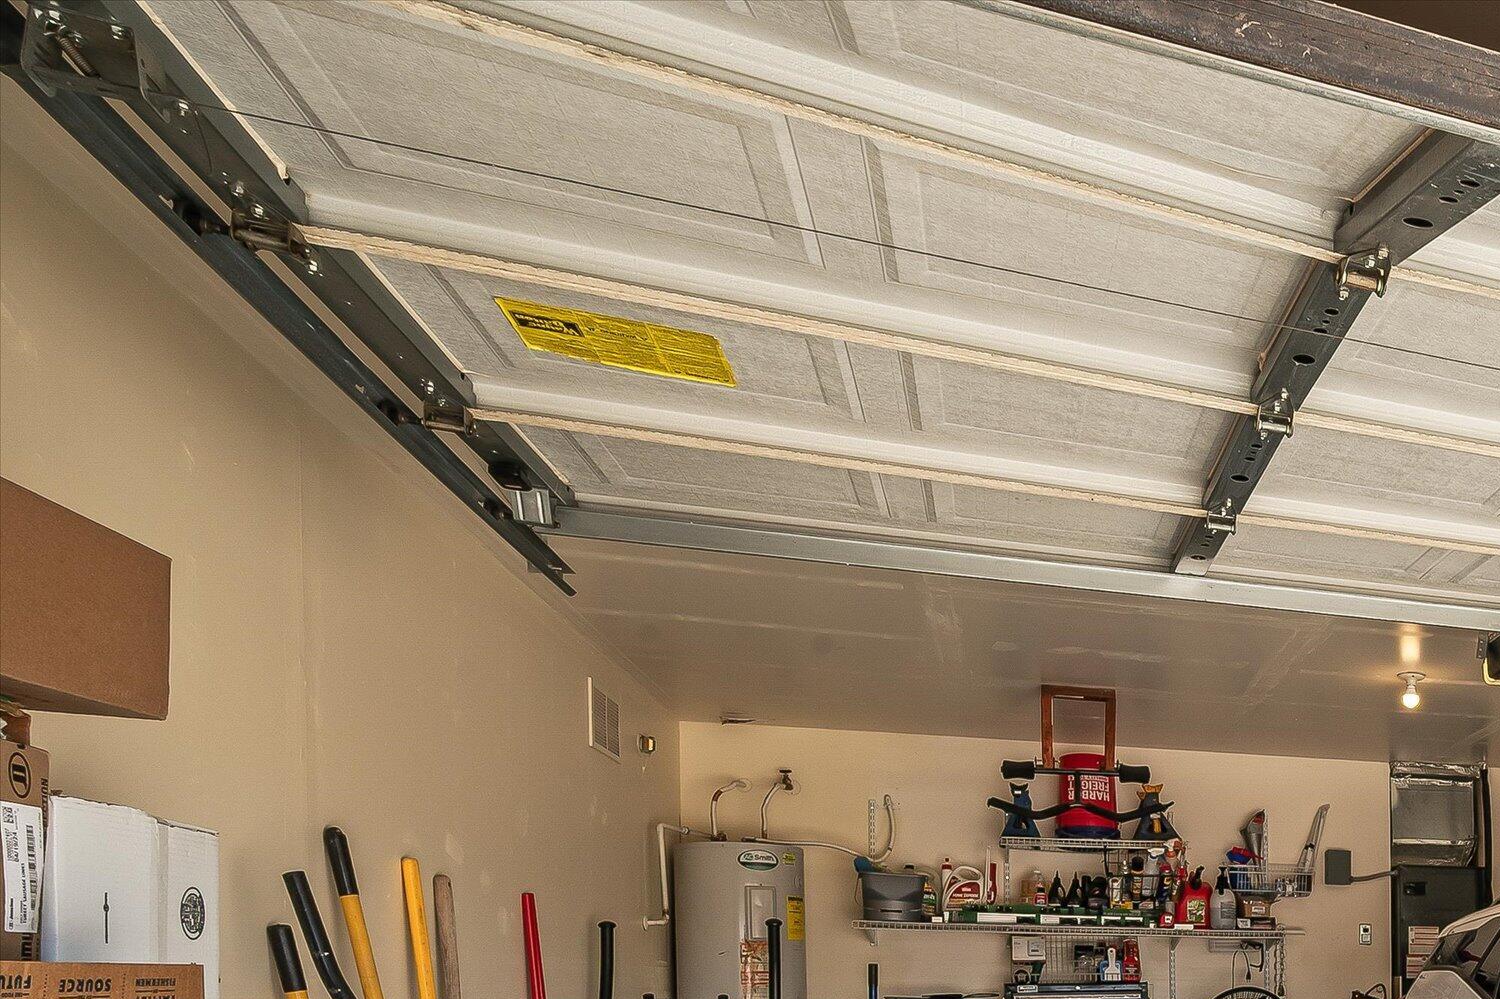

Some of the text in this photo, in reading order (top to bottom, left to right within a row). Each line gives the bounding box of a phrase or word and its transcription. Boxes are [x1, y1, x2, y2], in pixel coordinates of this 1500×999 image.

[1067, 780, 1110, 792] FREIGT
[1067, 790, 1110, 802] HARBR
[58, 978, 112, 993] SOURCE
[135, 977, 176, 987] FISHERMEN
